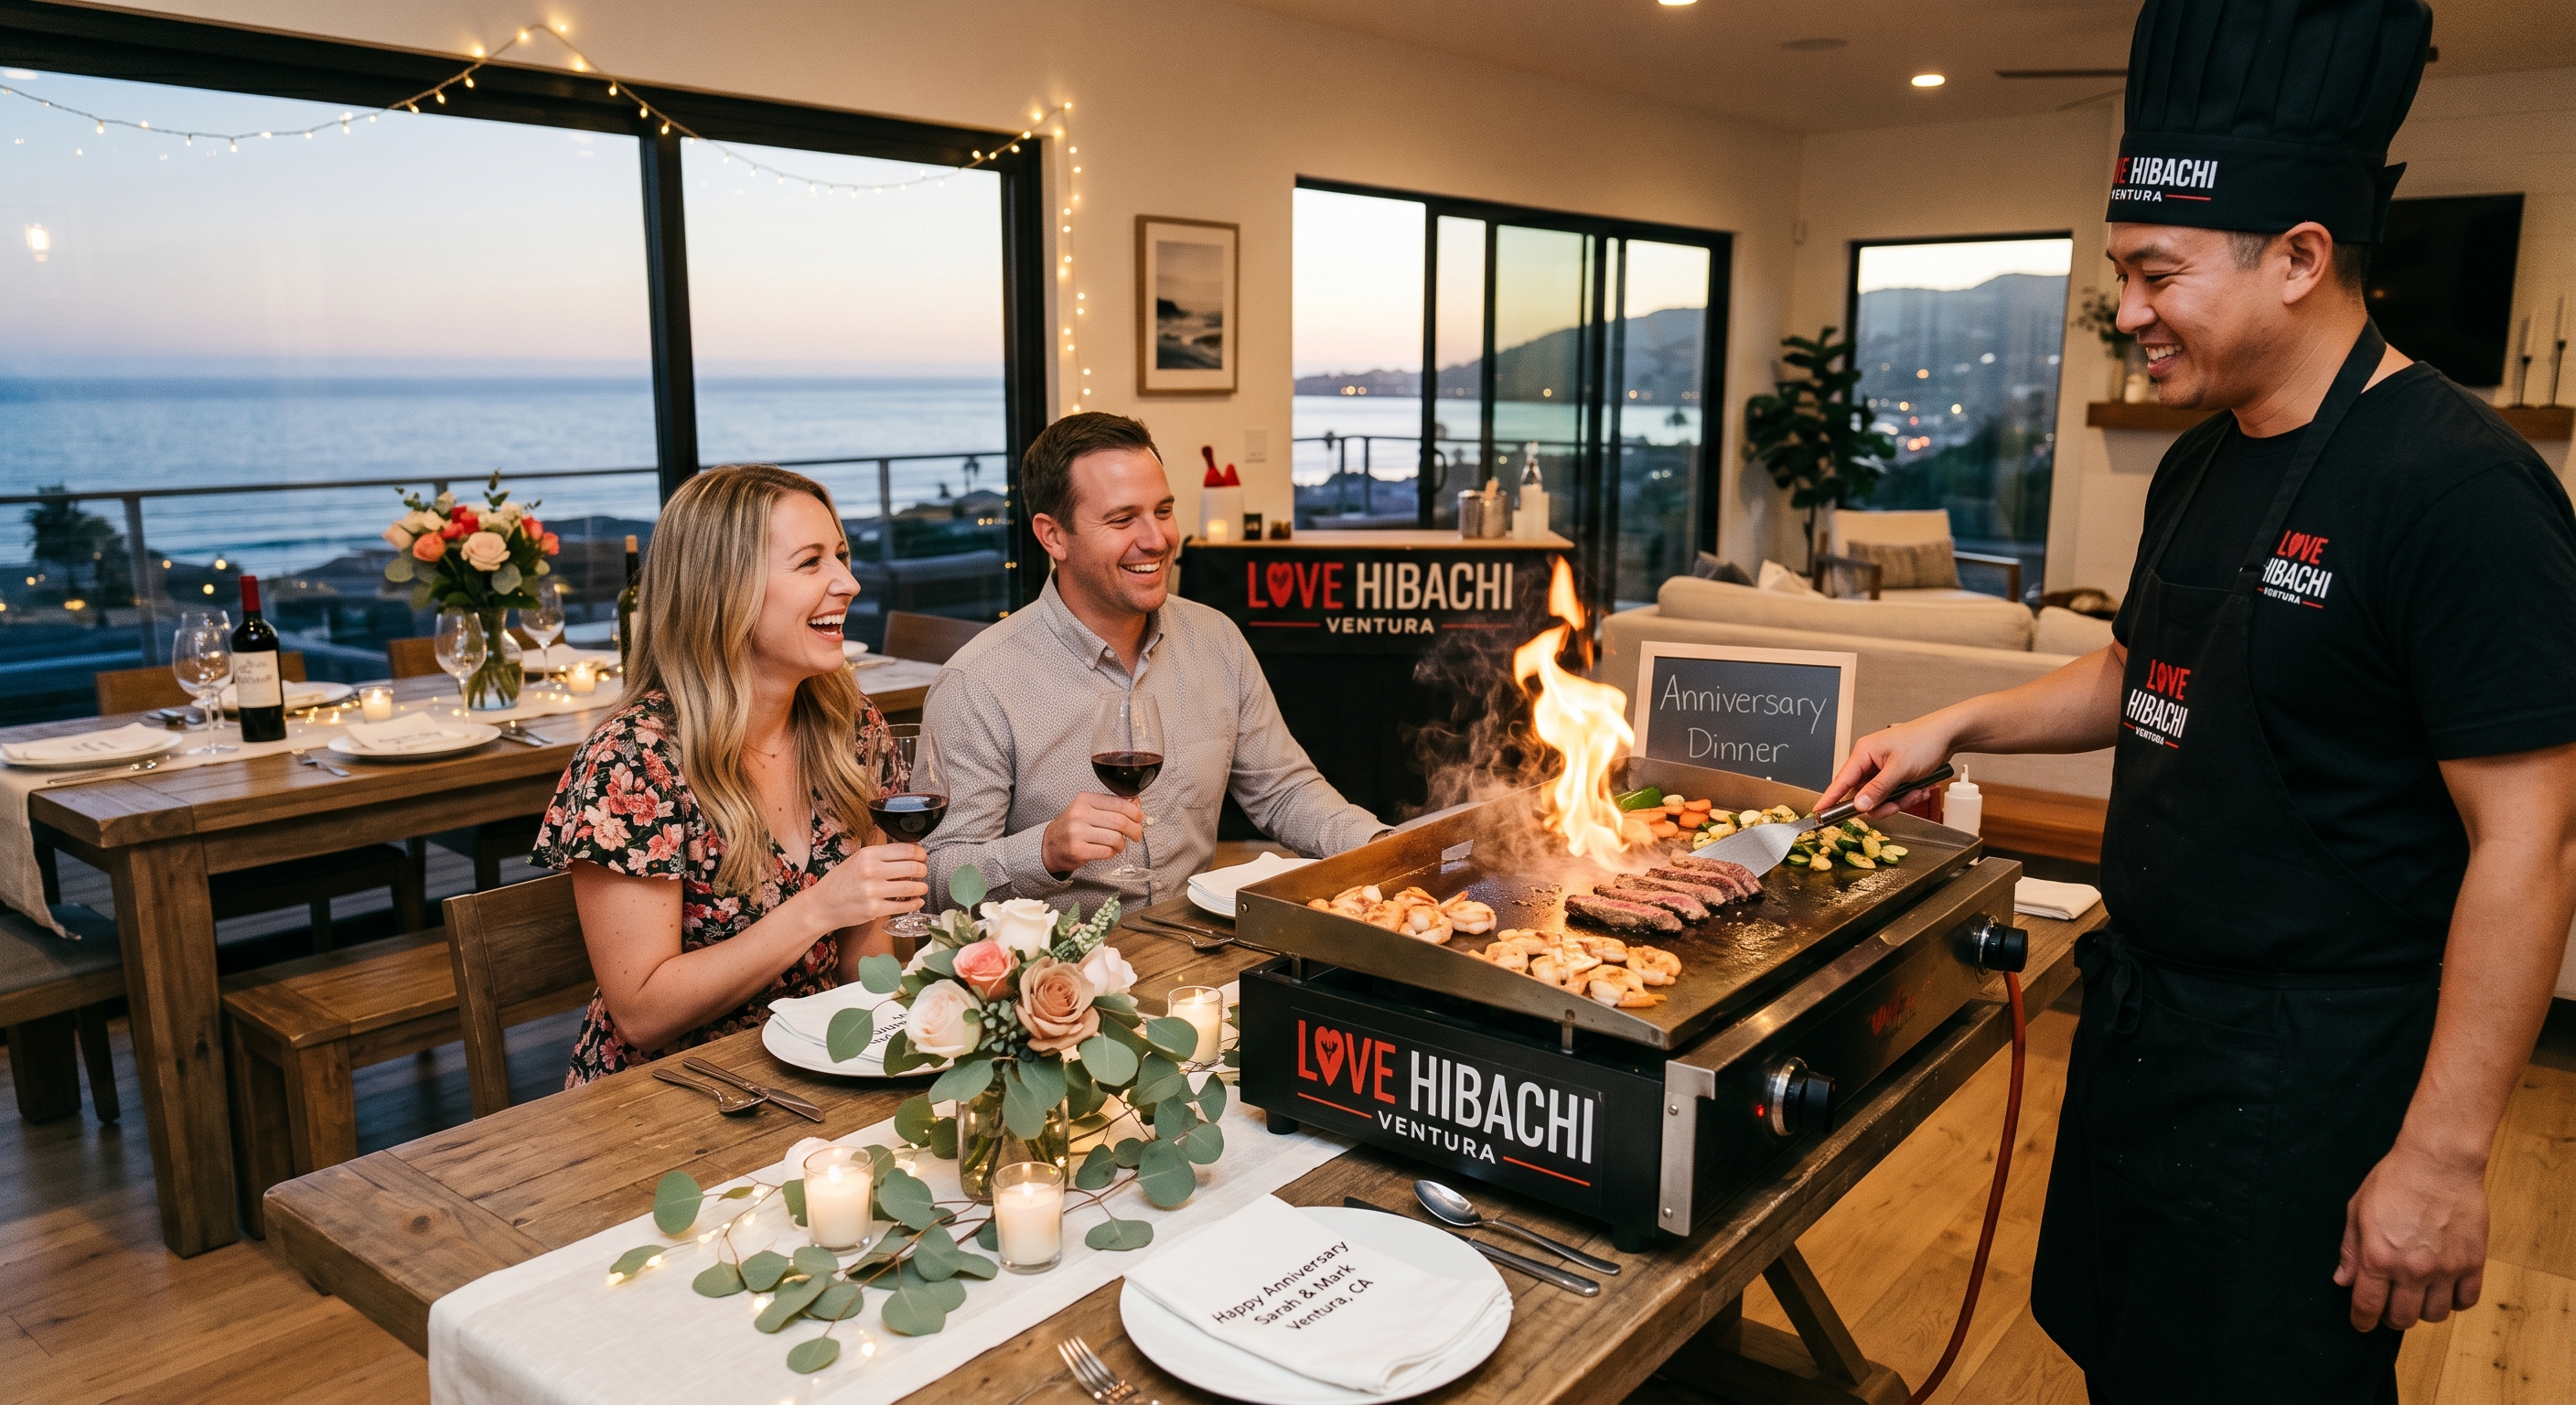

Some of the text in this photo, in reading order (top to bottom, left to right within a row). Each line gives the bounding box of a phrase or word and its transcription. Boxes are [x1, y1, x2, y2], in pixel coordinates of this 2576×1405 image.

[2130, 156, 2218, 189] HIBACHI
[2276, 530, 2329, 565] LOVE
[1247, 561, 1514, 611] LOVE HIBACHI
[1326, 617, 1435, 635] VENTURA
[1659, 673, 1828, 735] Anniversary
[2146, 659, 2191, 701] LOVE
[2126, 689, 2189, 739] HIBACHI
[1687, 727, 1789, 763] Dinner
[1297, 1019, 1594, 1164] LOVE HIBACHI
[1377, 1110, 1497, 1164] VENTURA
[1211, 1241, 1349, 1325] Happy Anniversary
[1254, 1264, 1357, 1325] Sarah & Mark
[1285, 1278, 1374, 1330] Ventura, CA
